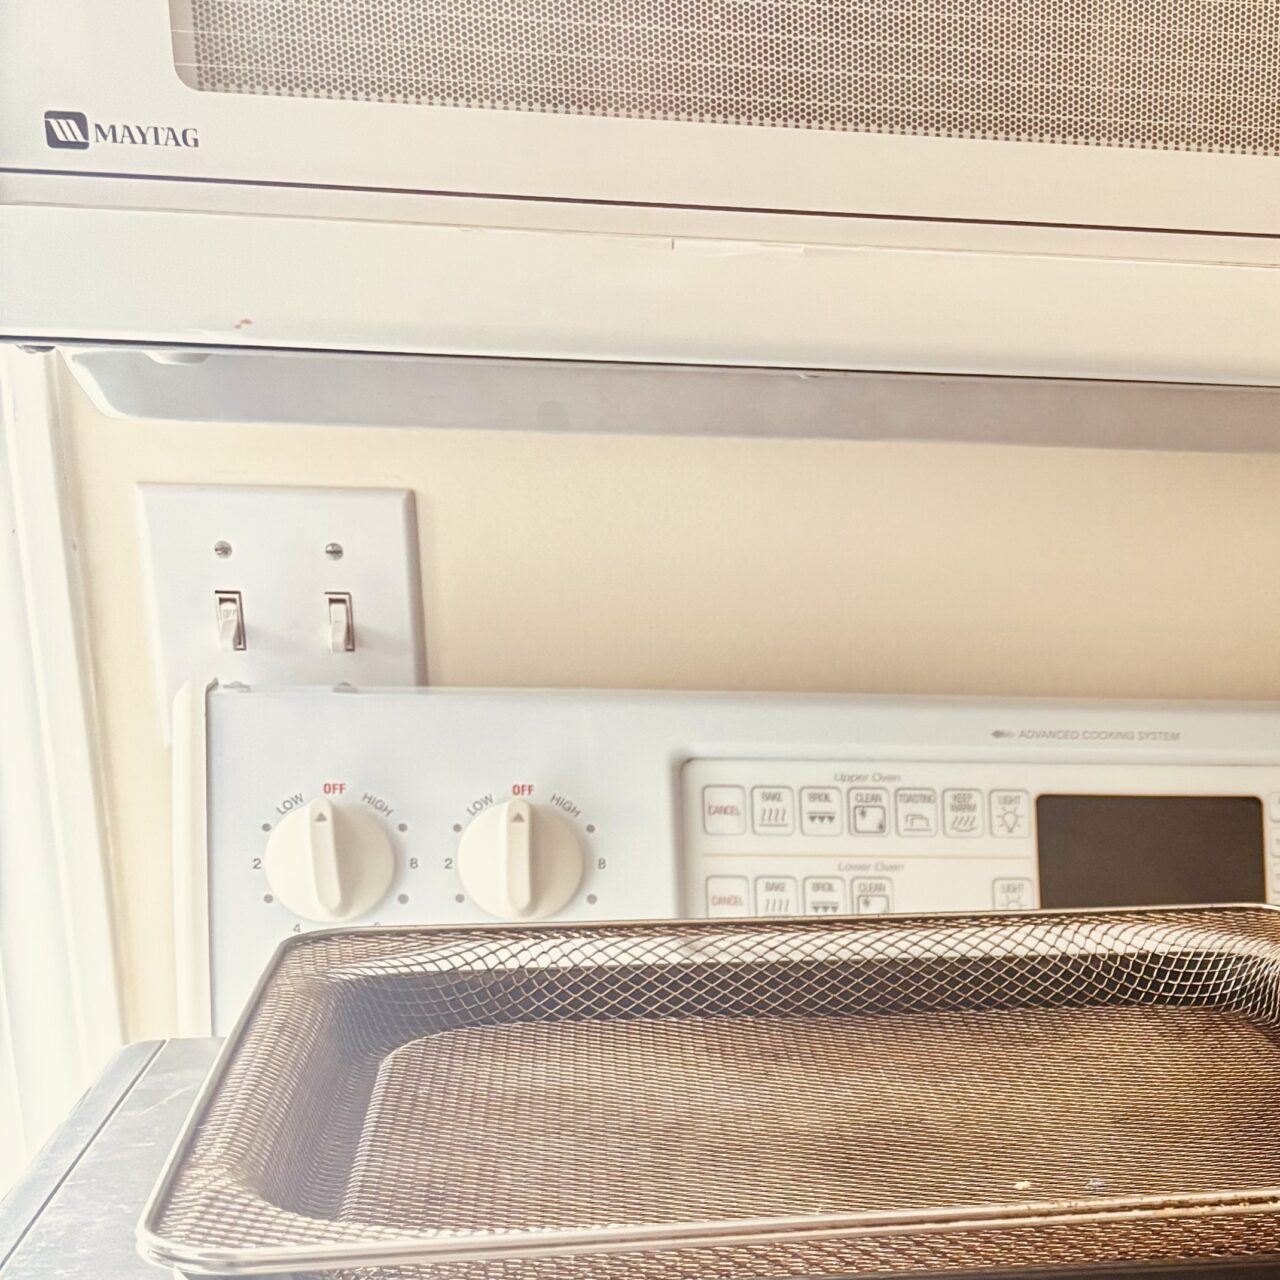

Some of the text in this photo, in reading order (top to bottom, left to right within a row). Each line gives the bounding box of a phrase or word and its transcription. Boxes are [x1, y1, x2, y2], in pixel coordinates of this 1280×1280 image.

[94, 123, 199, 148] MAYTAG
[323, 783, 346, 795] OFF
[512, 784, 535, 796] OFF
[275, 793, 304, 817] LOW
[362, 792, 394, 818] HIGH
[466, 793, 495, 818] LOW
[549, 793, 581, 819] HIGH
[708, 804, 741, 816] CANCEL
[252, 858, 262, 869] 2
[409, 858, 419, 869] 8
[444, 858, 454, 870] 2
[711, 894, 744, 906] CANCEL
